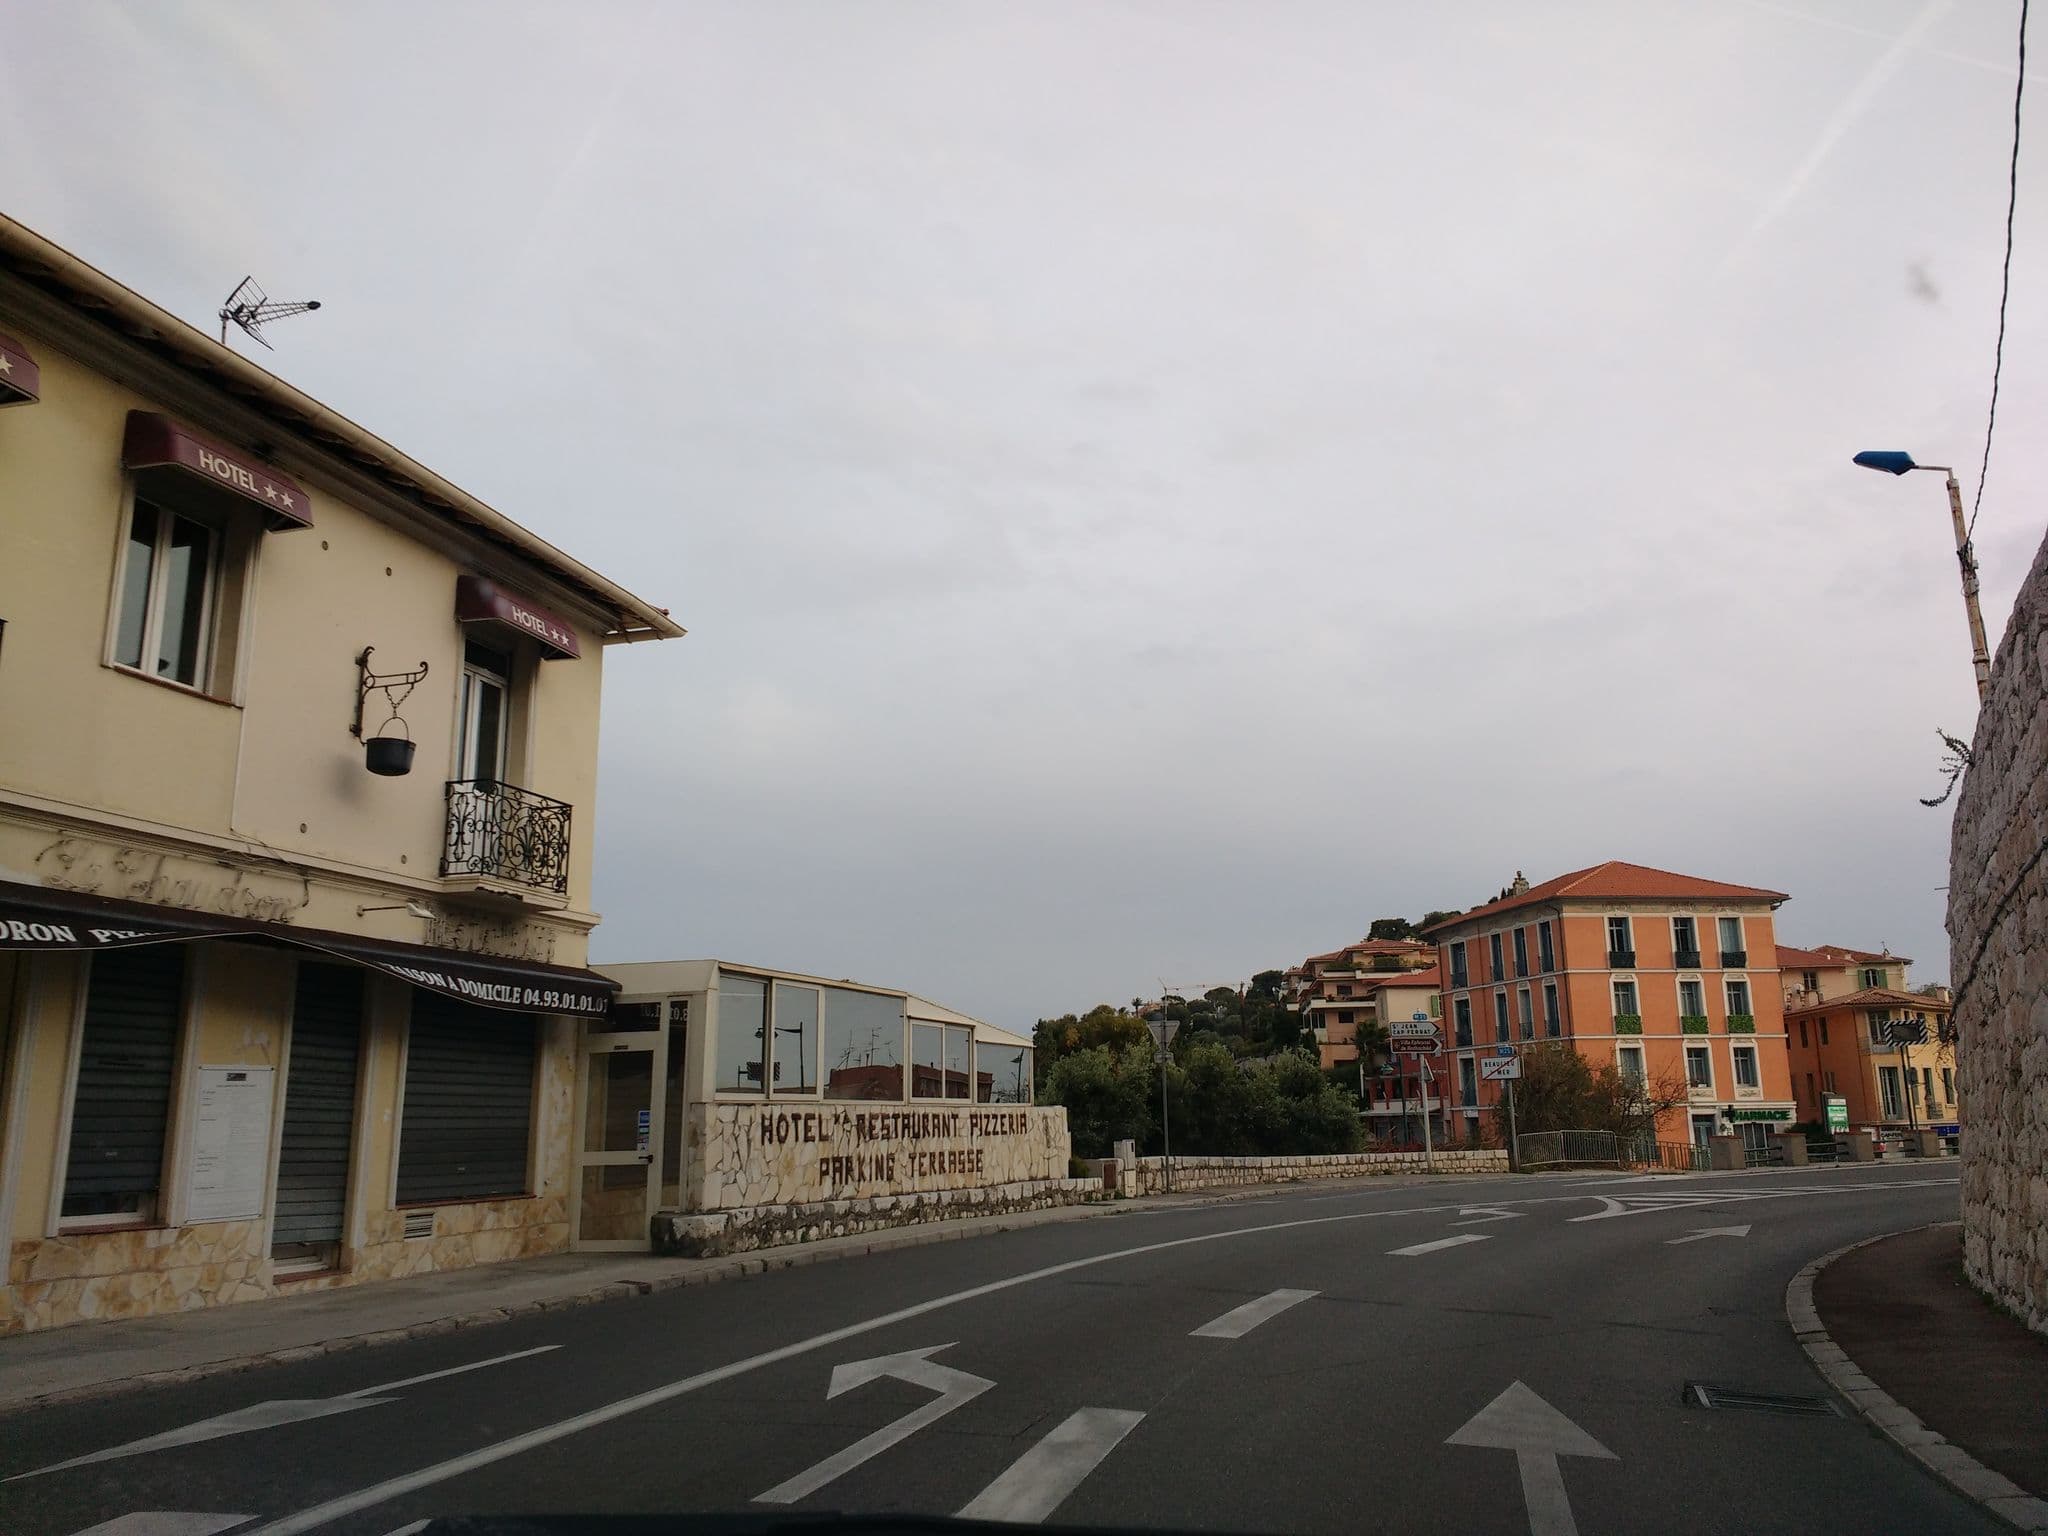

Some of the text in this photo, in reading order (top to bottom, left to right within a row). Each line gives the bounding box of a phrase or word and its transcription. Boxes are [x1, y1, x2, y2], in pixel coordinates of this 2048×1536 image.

[199, 449, 260, 493] HOTEL
[512, 605, 548, 636] HOTEL
[447, 974, 460, 991] A
[458, 977, 522, 1005] DOMICILE
[524, 988, 608, 1014] 04.93.01.01.01
[760, 1110, 1029, 1145] HOTEL RESTAURANT PIZZERIA
[818, 1149, 984, 1185] PARKING TERRASSE
